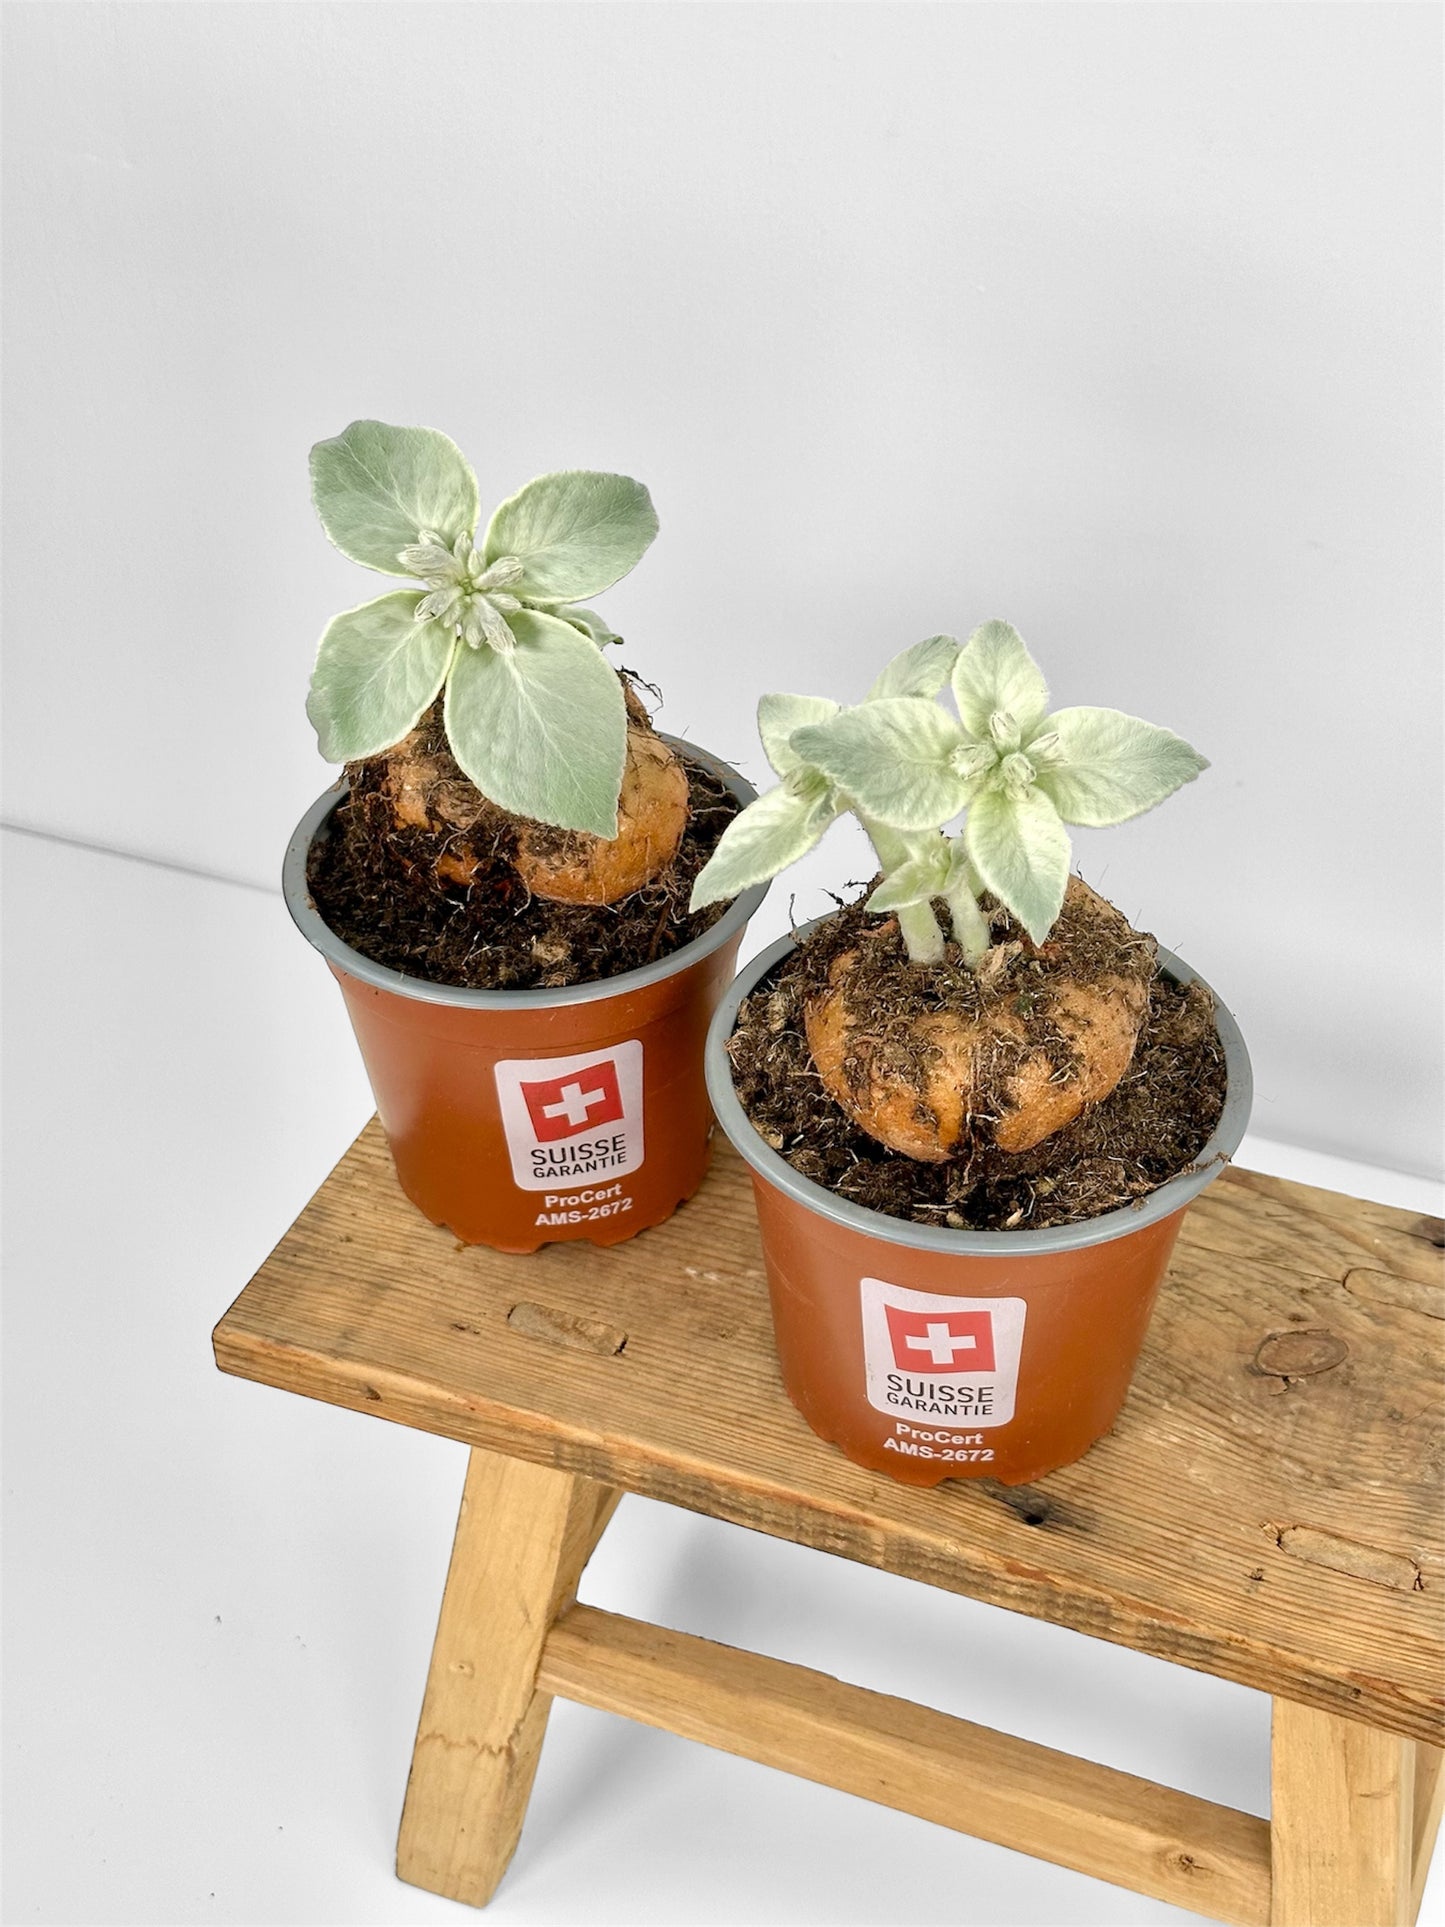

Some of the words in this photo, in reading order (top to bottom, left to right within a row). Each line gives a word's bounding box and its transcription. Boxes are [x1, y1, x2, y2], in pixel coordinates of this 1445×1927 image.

[531, 1133, 627, 1165] SUISSE
[533, 1151, 627, 1178] GARANTIE
[545, 1183, 622, 1208] ProCert
[535, 1197, 633, 1226] AMS-2672
[887, 1374, 995, 1403] SUISSE
[887, 1392, 993, 1415] GARANTIE
[896, 1422, 984, 1445] ProCert
[883, 1437, 995, 1462] AMS-2672
